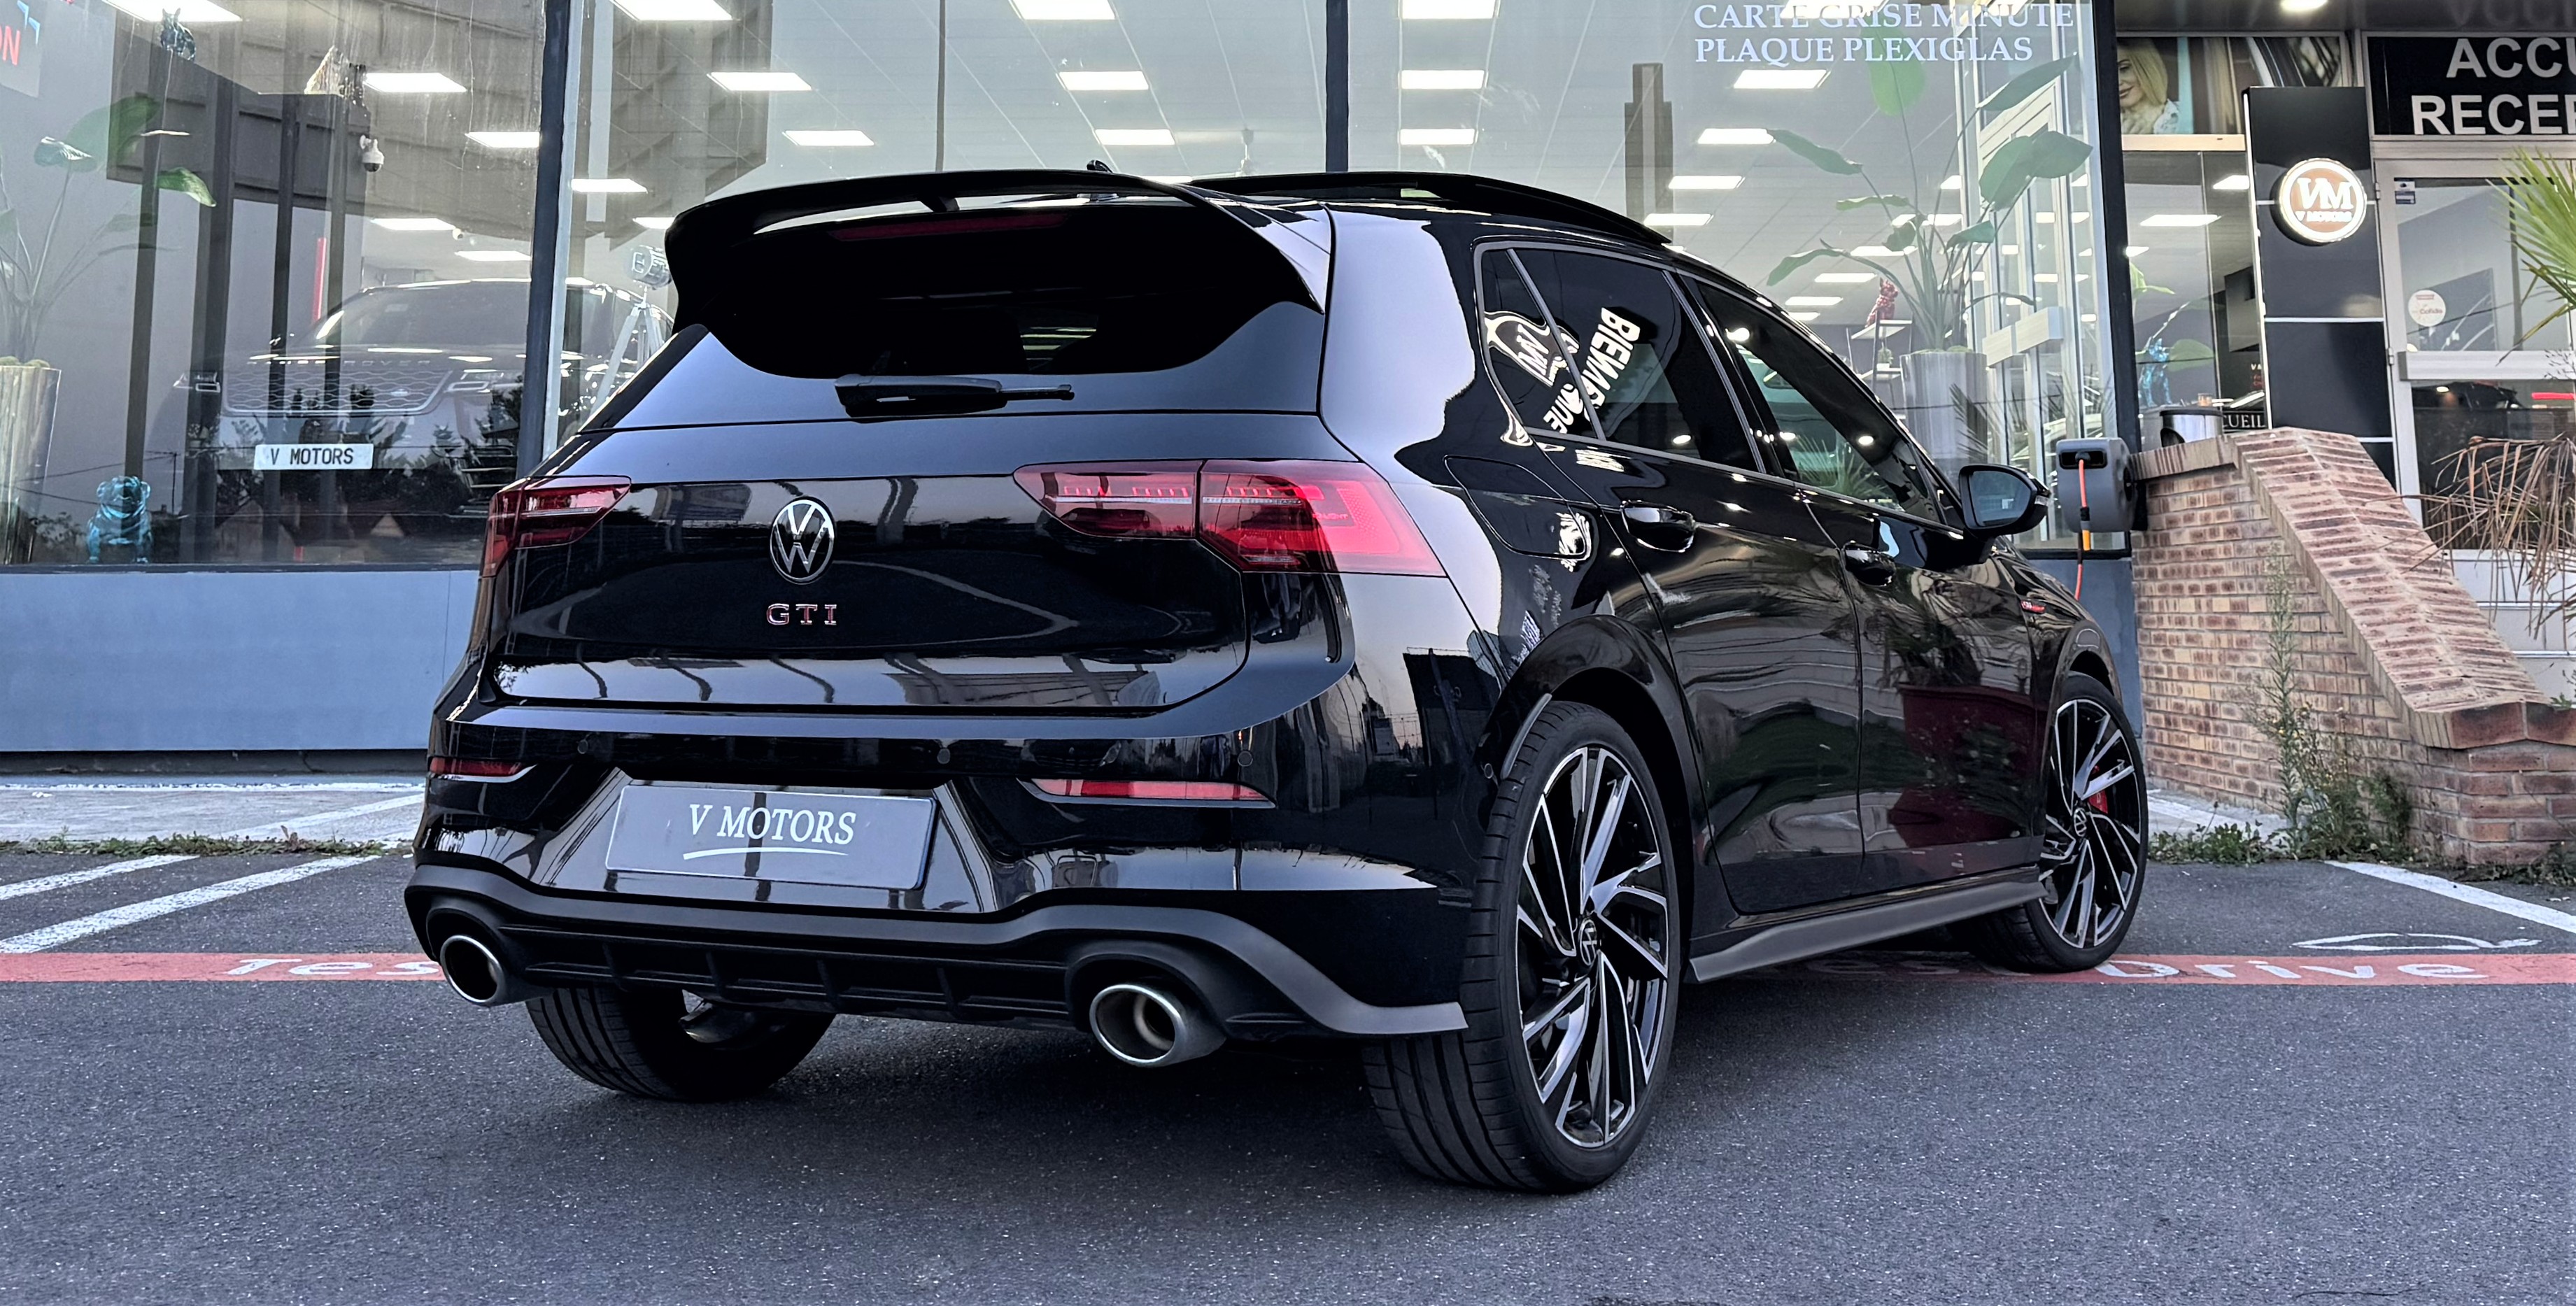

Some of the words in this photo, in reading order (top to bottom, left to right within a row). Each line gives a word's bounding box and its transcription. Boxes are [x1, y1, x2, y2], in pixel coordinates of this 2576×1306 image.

[1694, 4, 1809, 29] CARTE
[1819, 3, 1923, 28] GRISE
[1931, 3, 2074, 27] MINUTE
[0, 25, 20, 66] N
[1694, 38, 1835, 66] PLAQUE
[1843, 37, 2033, 62] PLEXIGLAS
[2446, 37, 2576, 78] ACC
[2297, 177, 2354, 210] VM
[270, 448, 279, 465] V
[290, 448, 355, 465] MOTORS
[766, 602, 837, 626] GTI
[690, 804, 714, 836] V
[716, 805, 857, 845] MOTORS
[225, 958, 441, 975] Tes
[2095, 960, 2488, 979] Drive
